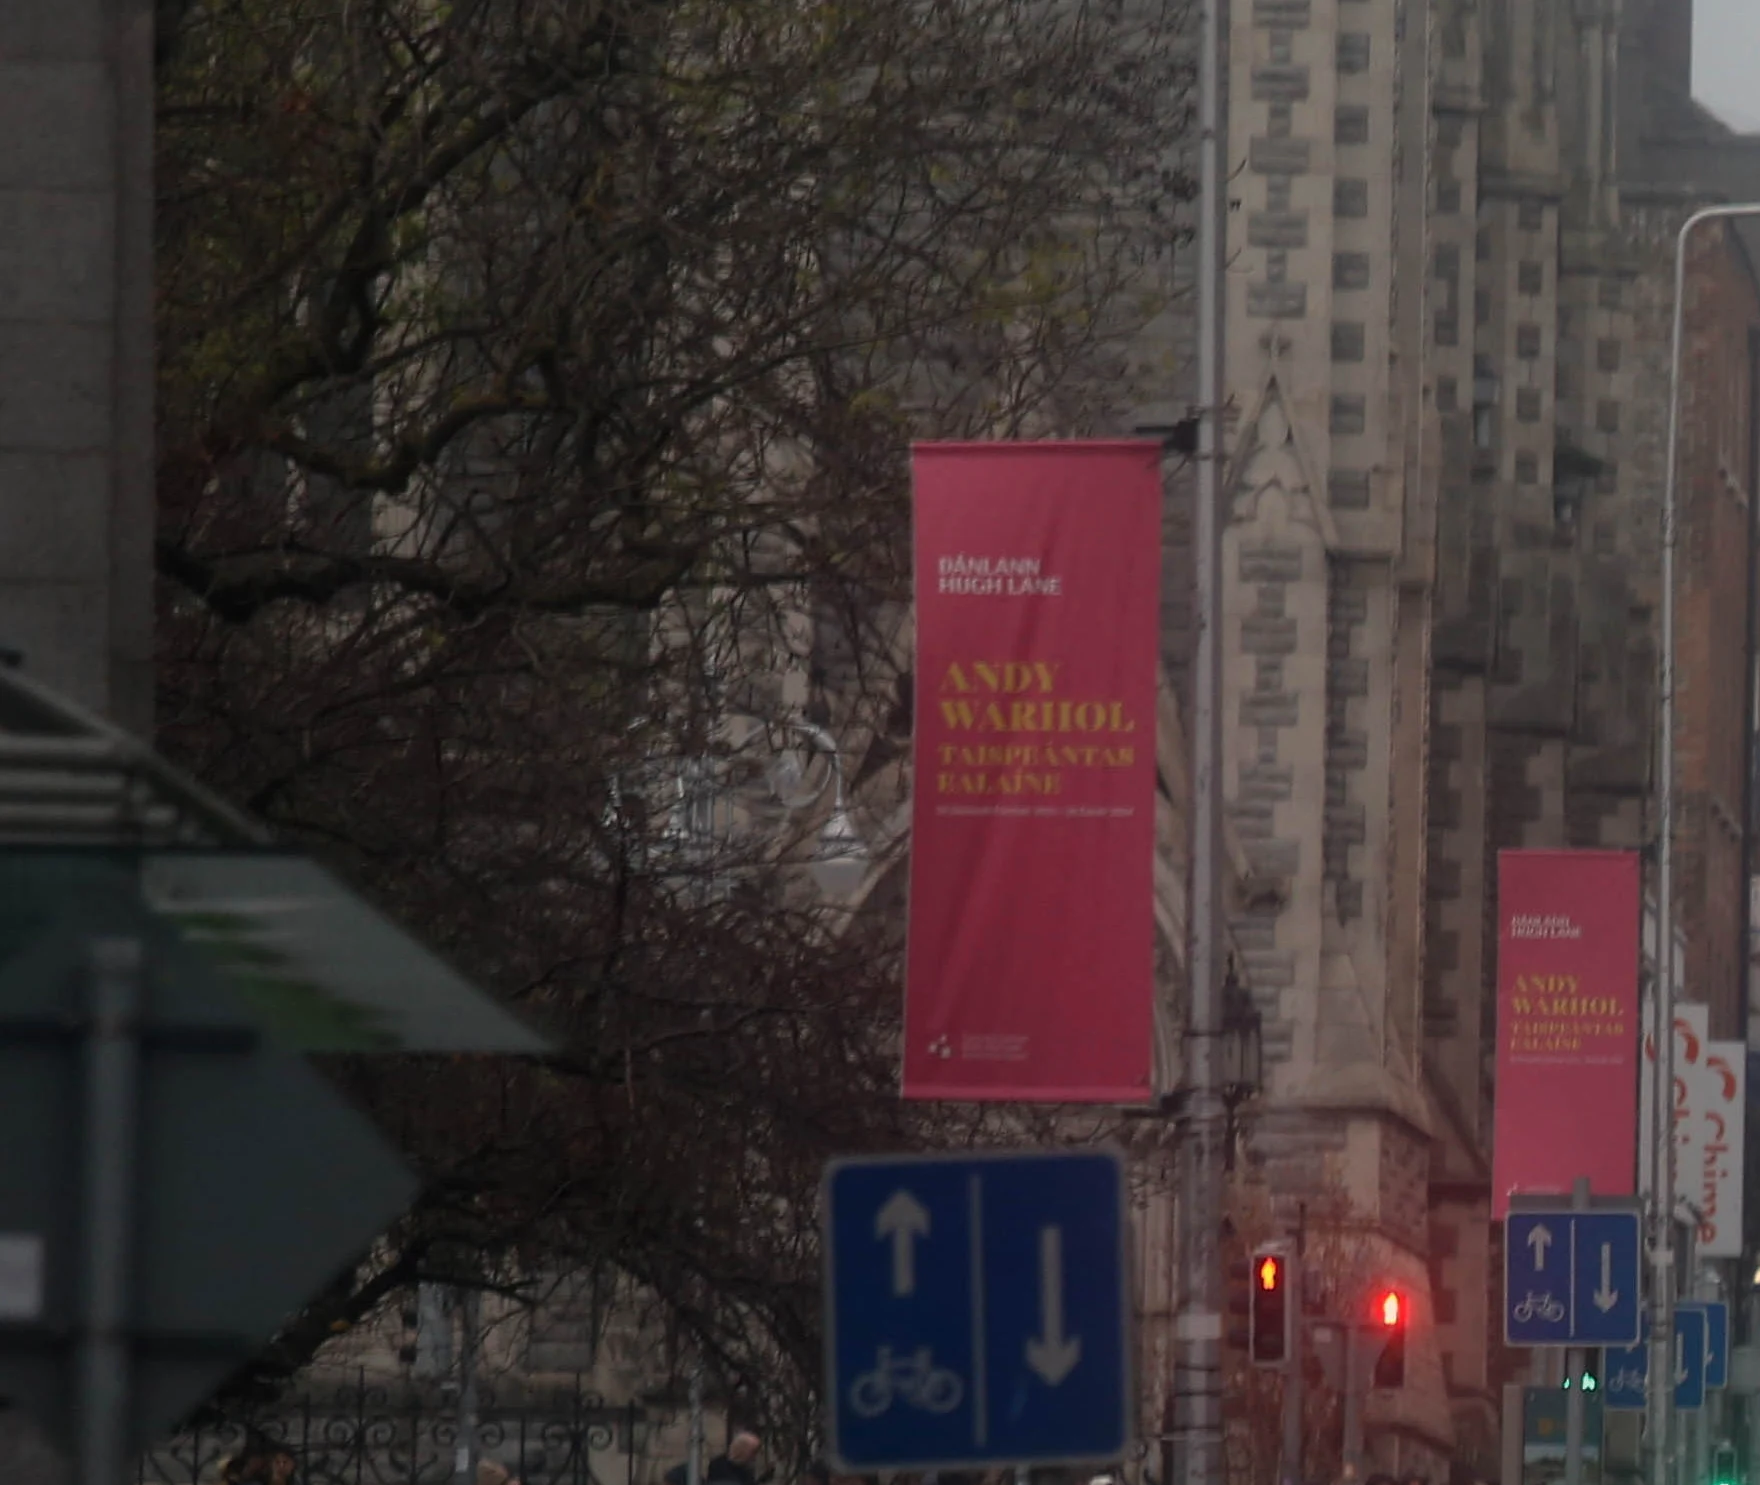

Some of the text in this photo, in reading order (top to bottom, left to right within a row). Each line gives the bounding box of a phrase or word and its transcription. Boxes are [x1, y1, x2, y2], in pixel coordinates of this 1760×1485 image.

[938, 576, 1063, 596] HUGH LANE
[940, 660, 1063, 694] ANDY
[939, 700, 1136, 732] WARHOL
[1513, 974, 1579, 994] ANDY
[1511, 996, 1625, 1016] WARHOL
